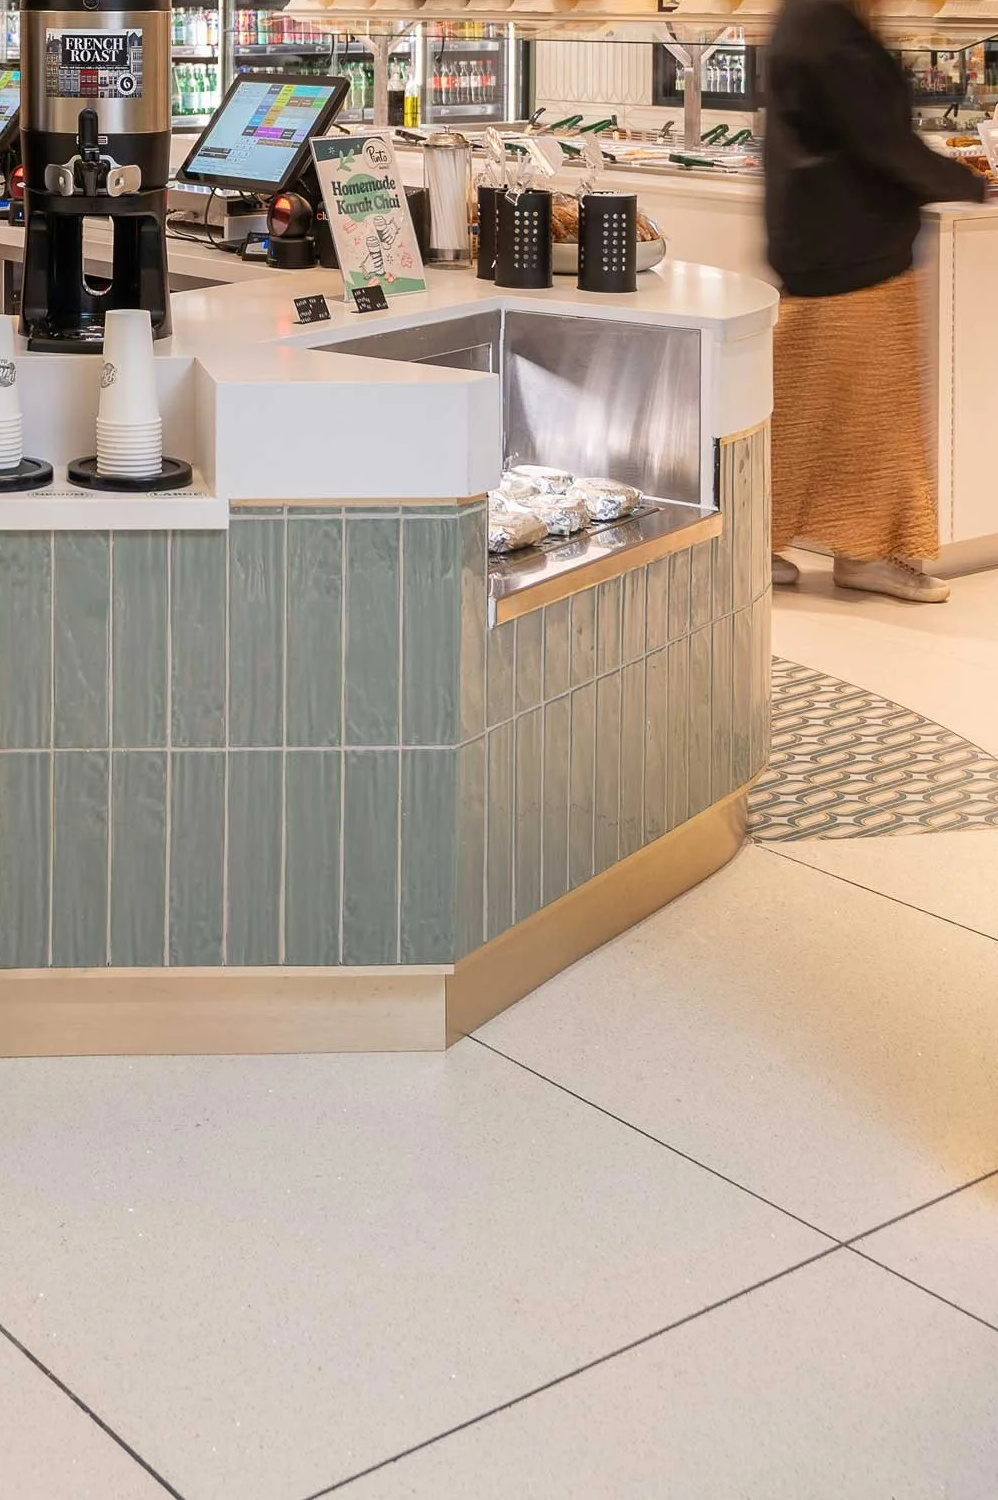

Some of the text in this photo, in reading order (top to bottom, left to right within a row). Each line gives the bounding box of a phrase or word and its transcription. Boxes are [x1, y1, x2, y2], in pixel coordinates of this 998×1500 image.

[65, 37, 124, 50] FRENCH
[70, 49, 119, 62] ROAST
[123, 77, 132, 89] 6
[366, 145, 388, 163] Pinto
[331, 175, 396, 197] Homemade
[336, 194, 401, 215] Karak Chai
